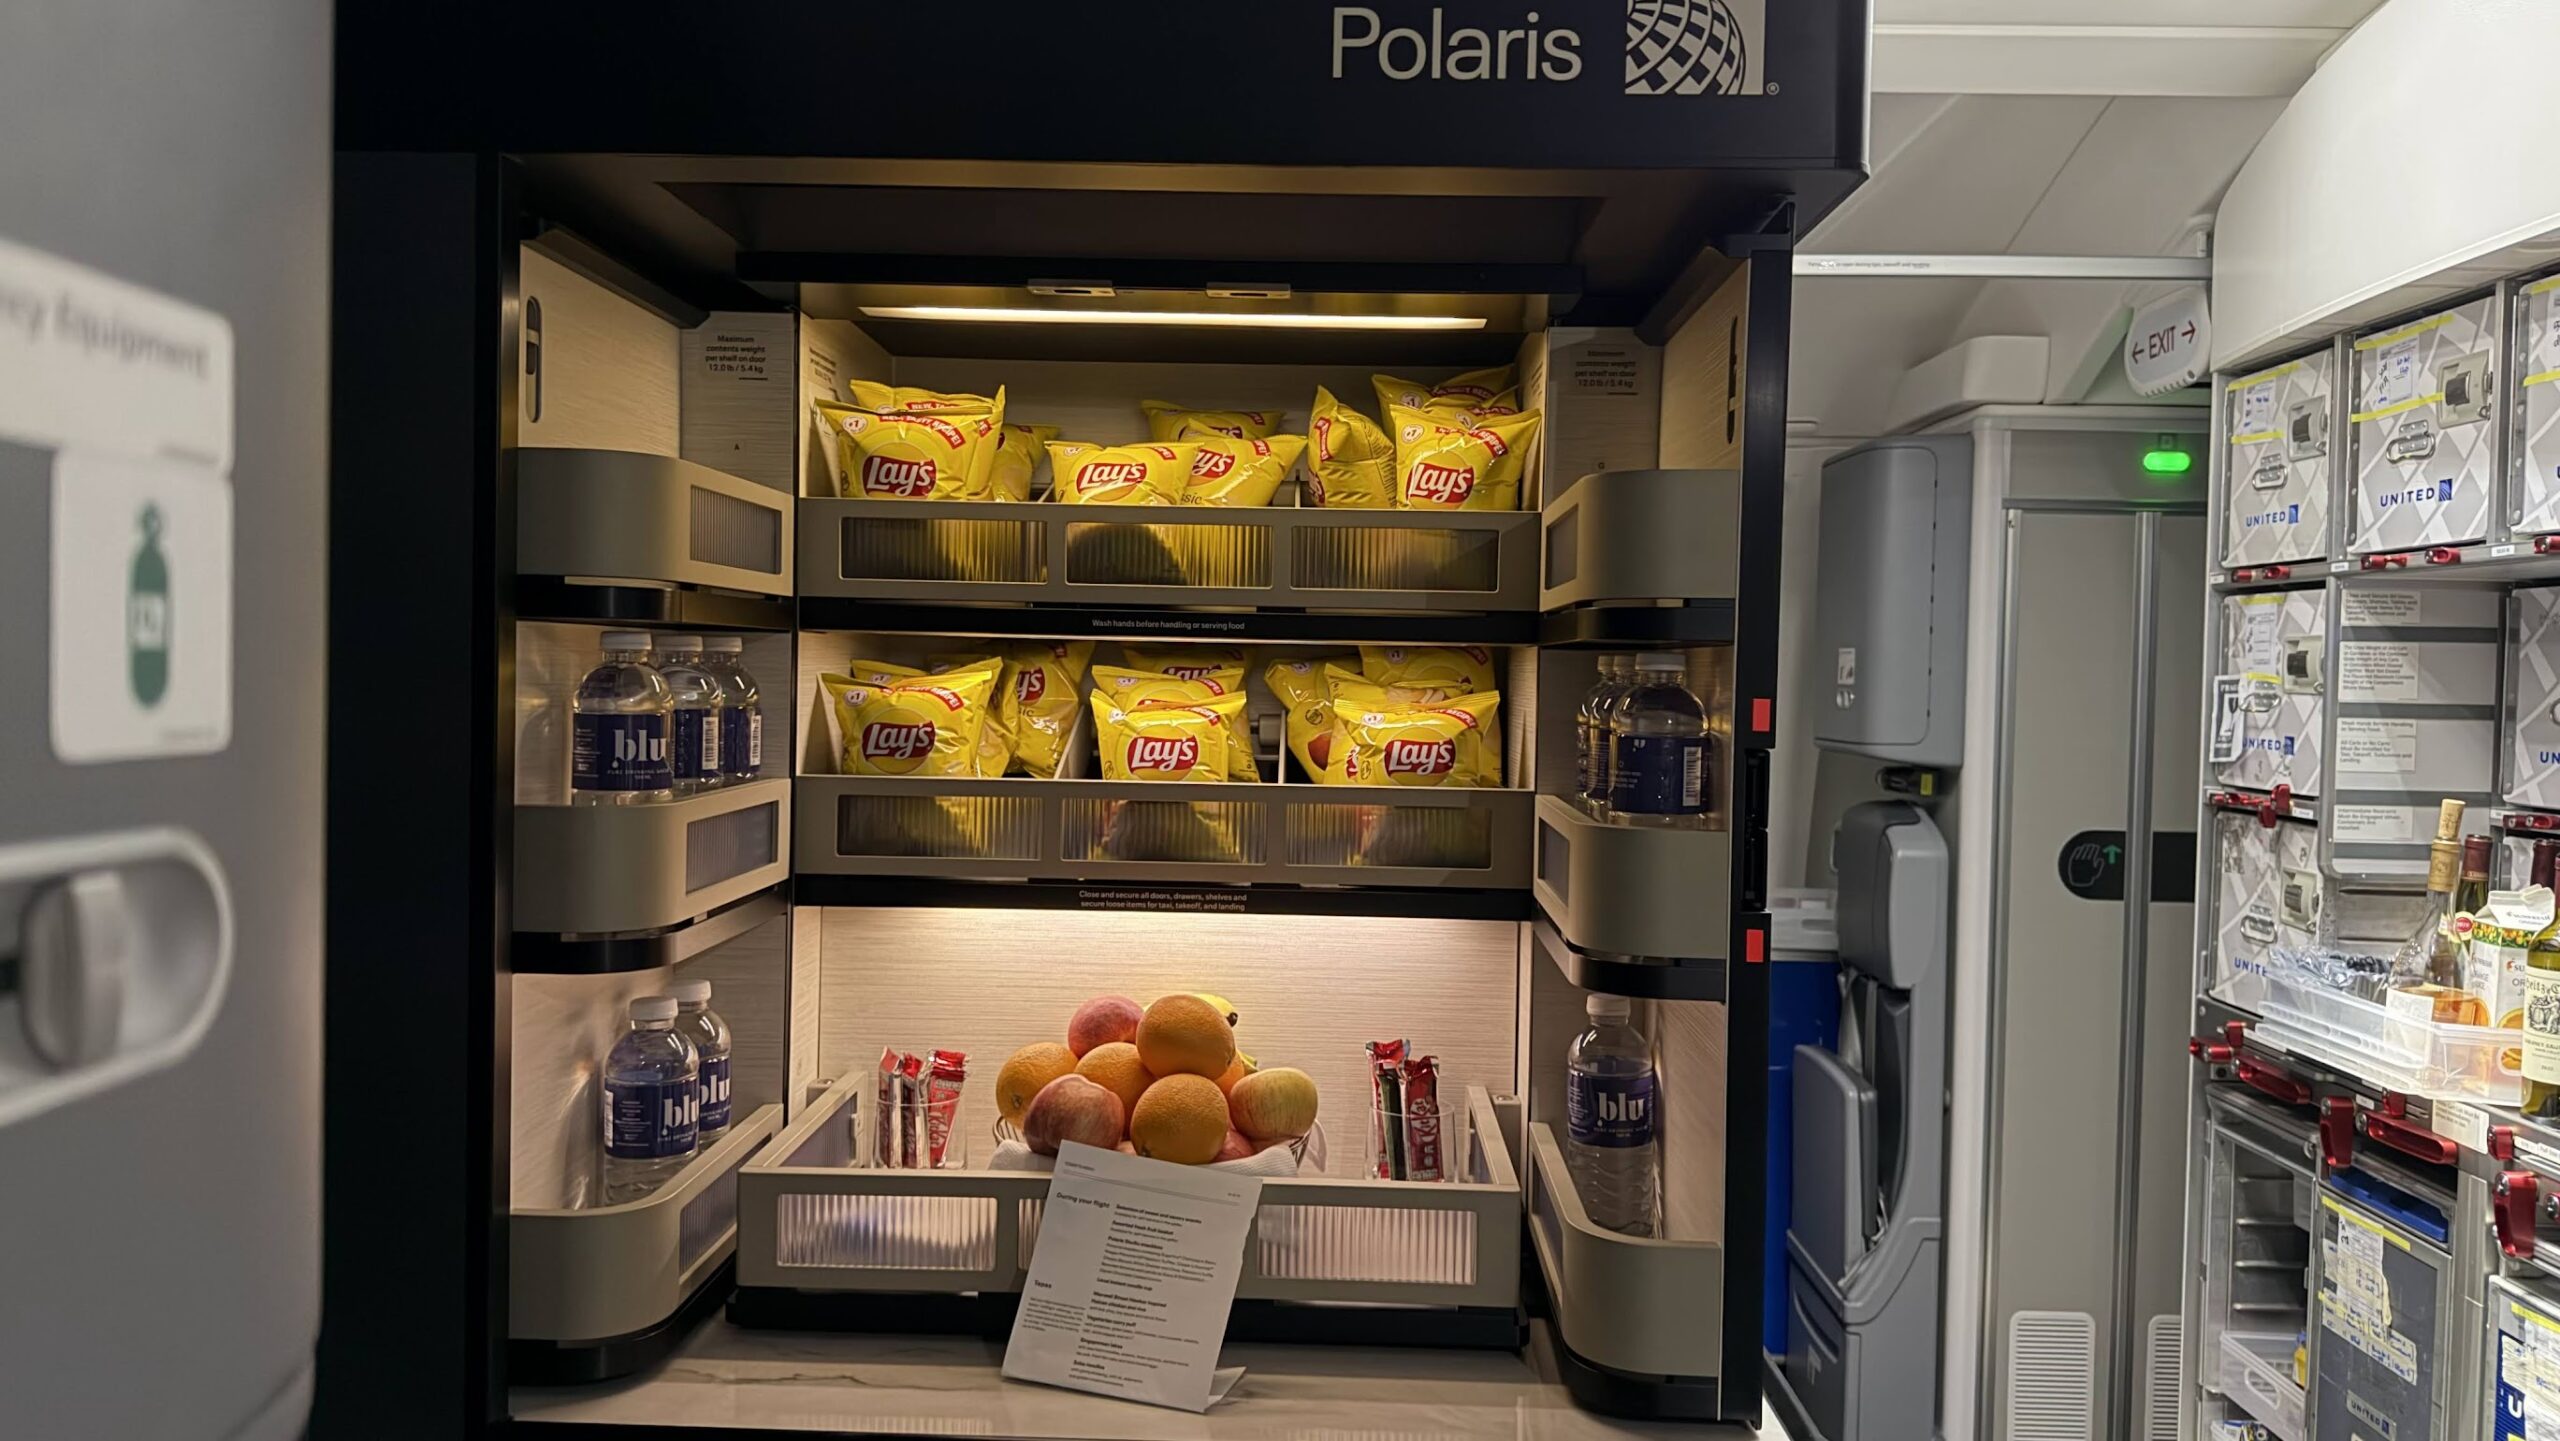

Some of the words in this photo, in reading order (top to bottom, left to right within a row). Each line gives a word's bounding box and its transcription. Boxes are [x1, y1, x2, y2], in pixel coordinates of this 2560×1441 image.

[1332, 7, 1583, 81] Polaris
[740, 347, 765, 355] weight
[2149, 325, 2177, 361] EXIT
[866, 457, 934, 497] Lay's
[1080, 463, 1144, 488] Lay's
[1410, 464, 1472, 503] Lay's
[2380, 486, 2434, 508] UNITED
[2246, 512, 2285, 527] UNITED
[1092, 619, 1112, 627] Wash
[1136, 620, 1160, 628] before
[1160, 621, 1192, 630] handling
[1201, 623, 1227, 631] serving
[1228, 622, 1245, 630] food
[615, 729, 667, 761] blu
[866, 724, 933, 759] Lay's
[1131, 738, 1196, 771] Lay's
[2242, 738, 2281, 751] UNITED
[1389, 740, 1452, 775] Lay's
[1079, 890, 1099, 898] Close
[1140, 891, 1149, 899] all
[1150, 892, 1173, 900] doors,
[1173, 892, 1204, 901] drawers,
[1205, 893, 1232, 901] shelves
[1233, 893, 1247, 901] and
[1106, 900, 1125, 908] loose
[1147, 901, 1158, 909] for
[1158, 902, 1174, 910] taxi,
[1175, 902, 1202, 910] takeoff,
[1218, 903, 1245, 911] landing
[663, 1095, 699, 1128] blu
[1598, 1092, 1644, 1122] blu
[1055, 1191, 1078, 1203] During
[1078, 1196, 1093, 1206] your
[1093, 1199, 1111, 1210] flight
[1034, 1279, 1052, 1289] Tapas
